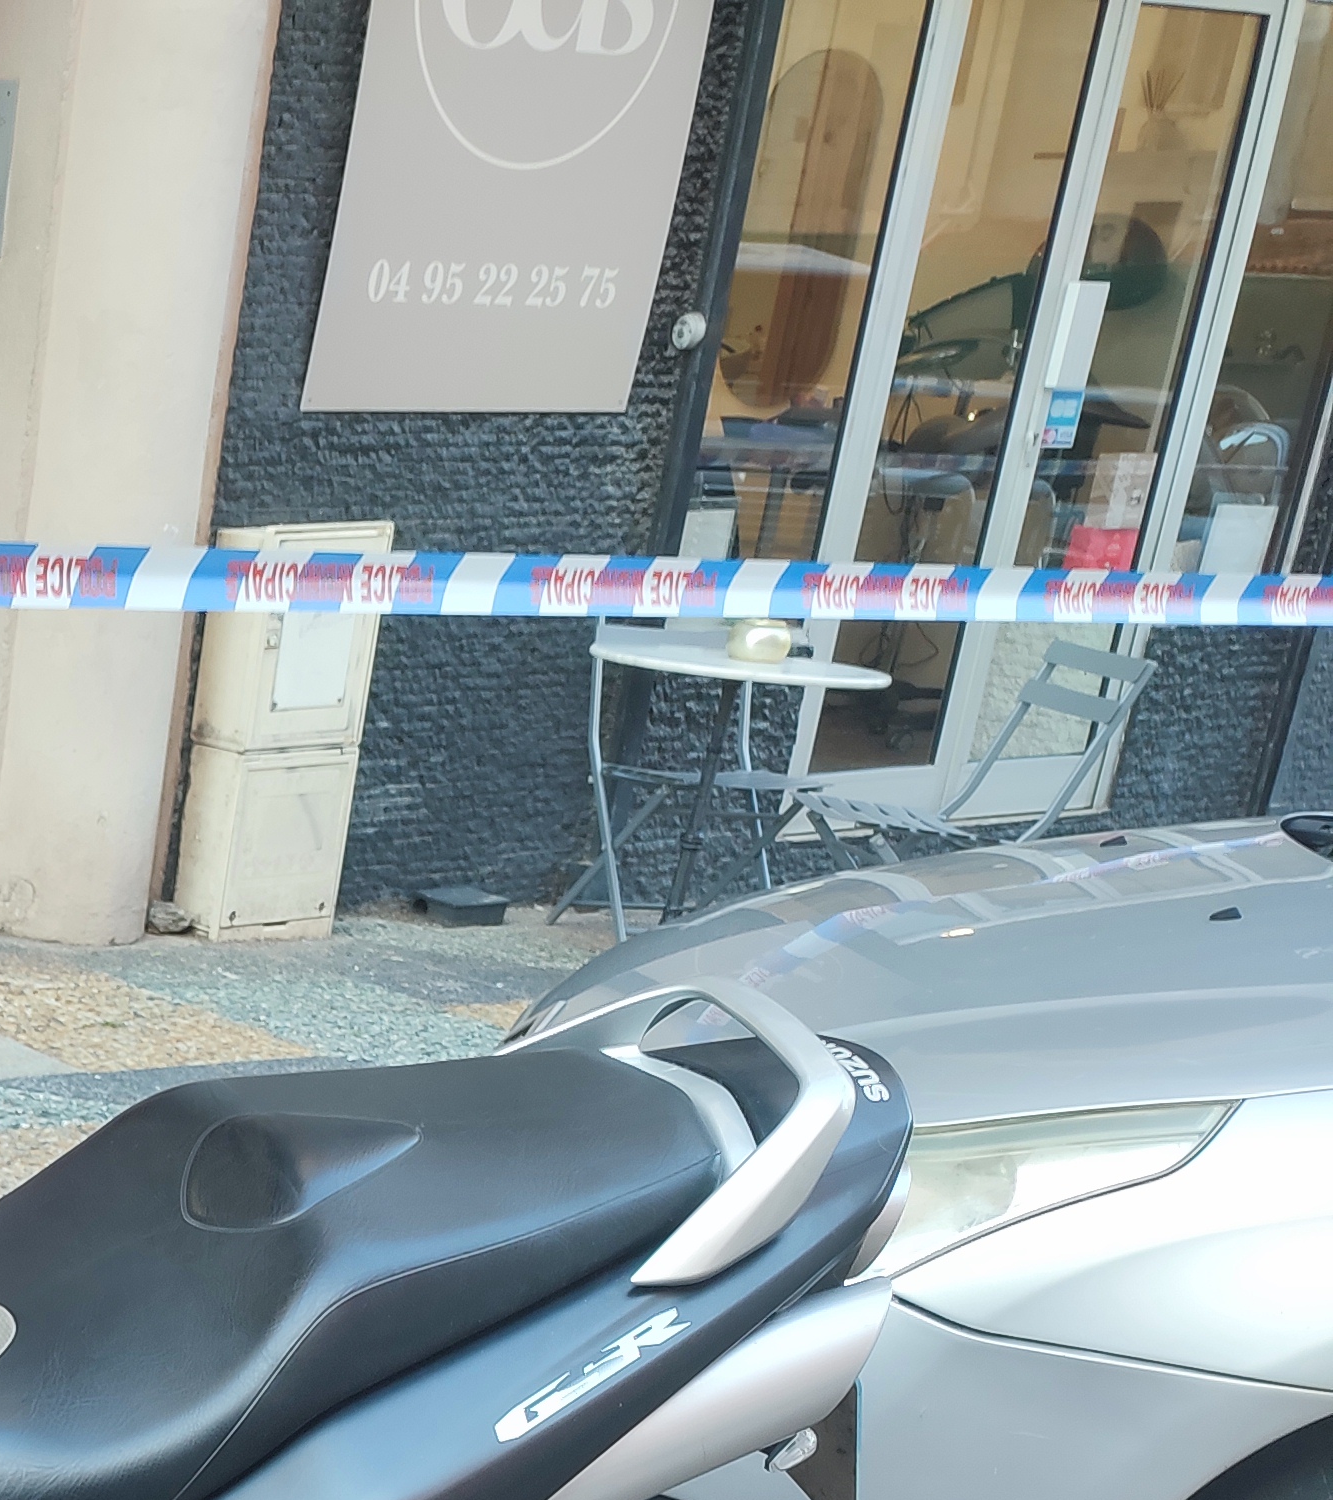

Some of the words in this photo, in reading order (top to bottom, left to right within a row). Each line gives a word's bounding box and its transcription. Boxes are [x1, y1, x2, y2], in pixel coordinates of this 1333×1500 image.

[368, 258, 411, 304] 04
[421, 259, 466, 305] 95
[474, 262, 519, 307] 22
[525, 263, 570, 308] 25
[579, 264, 619, 309] 75
